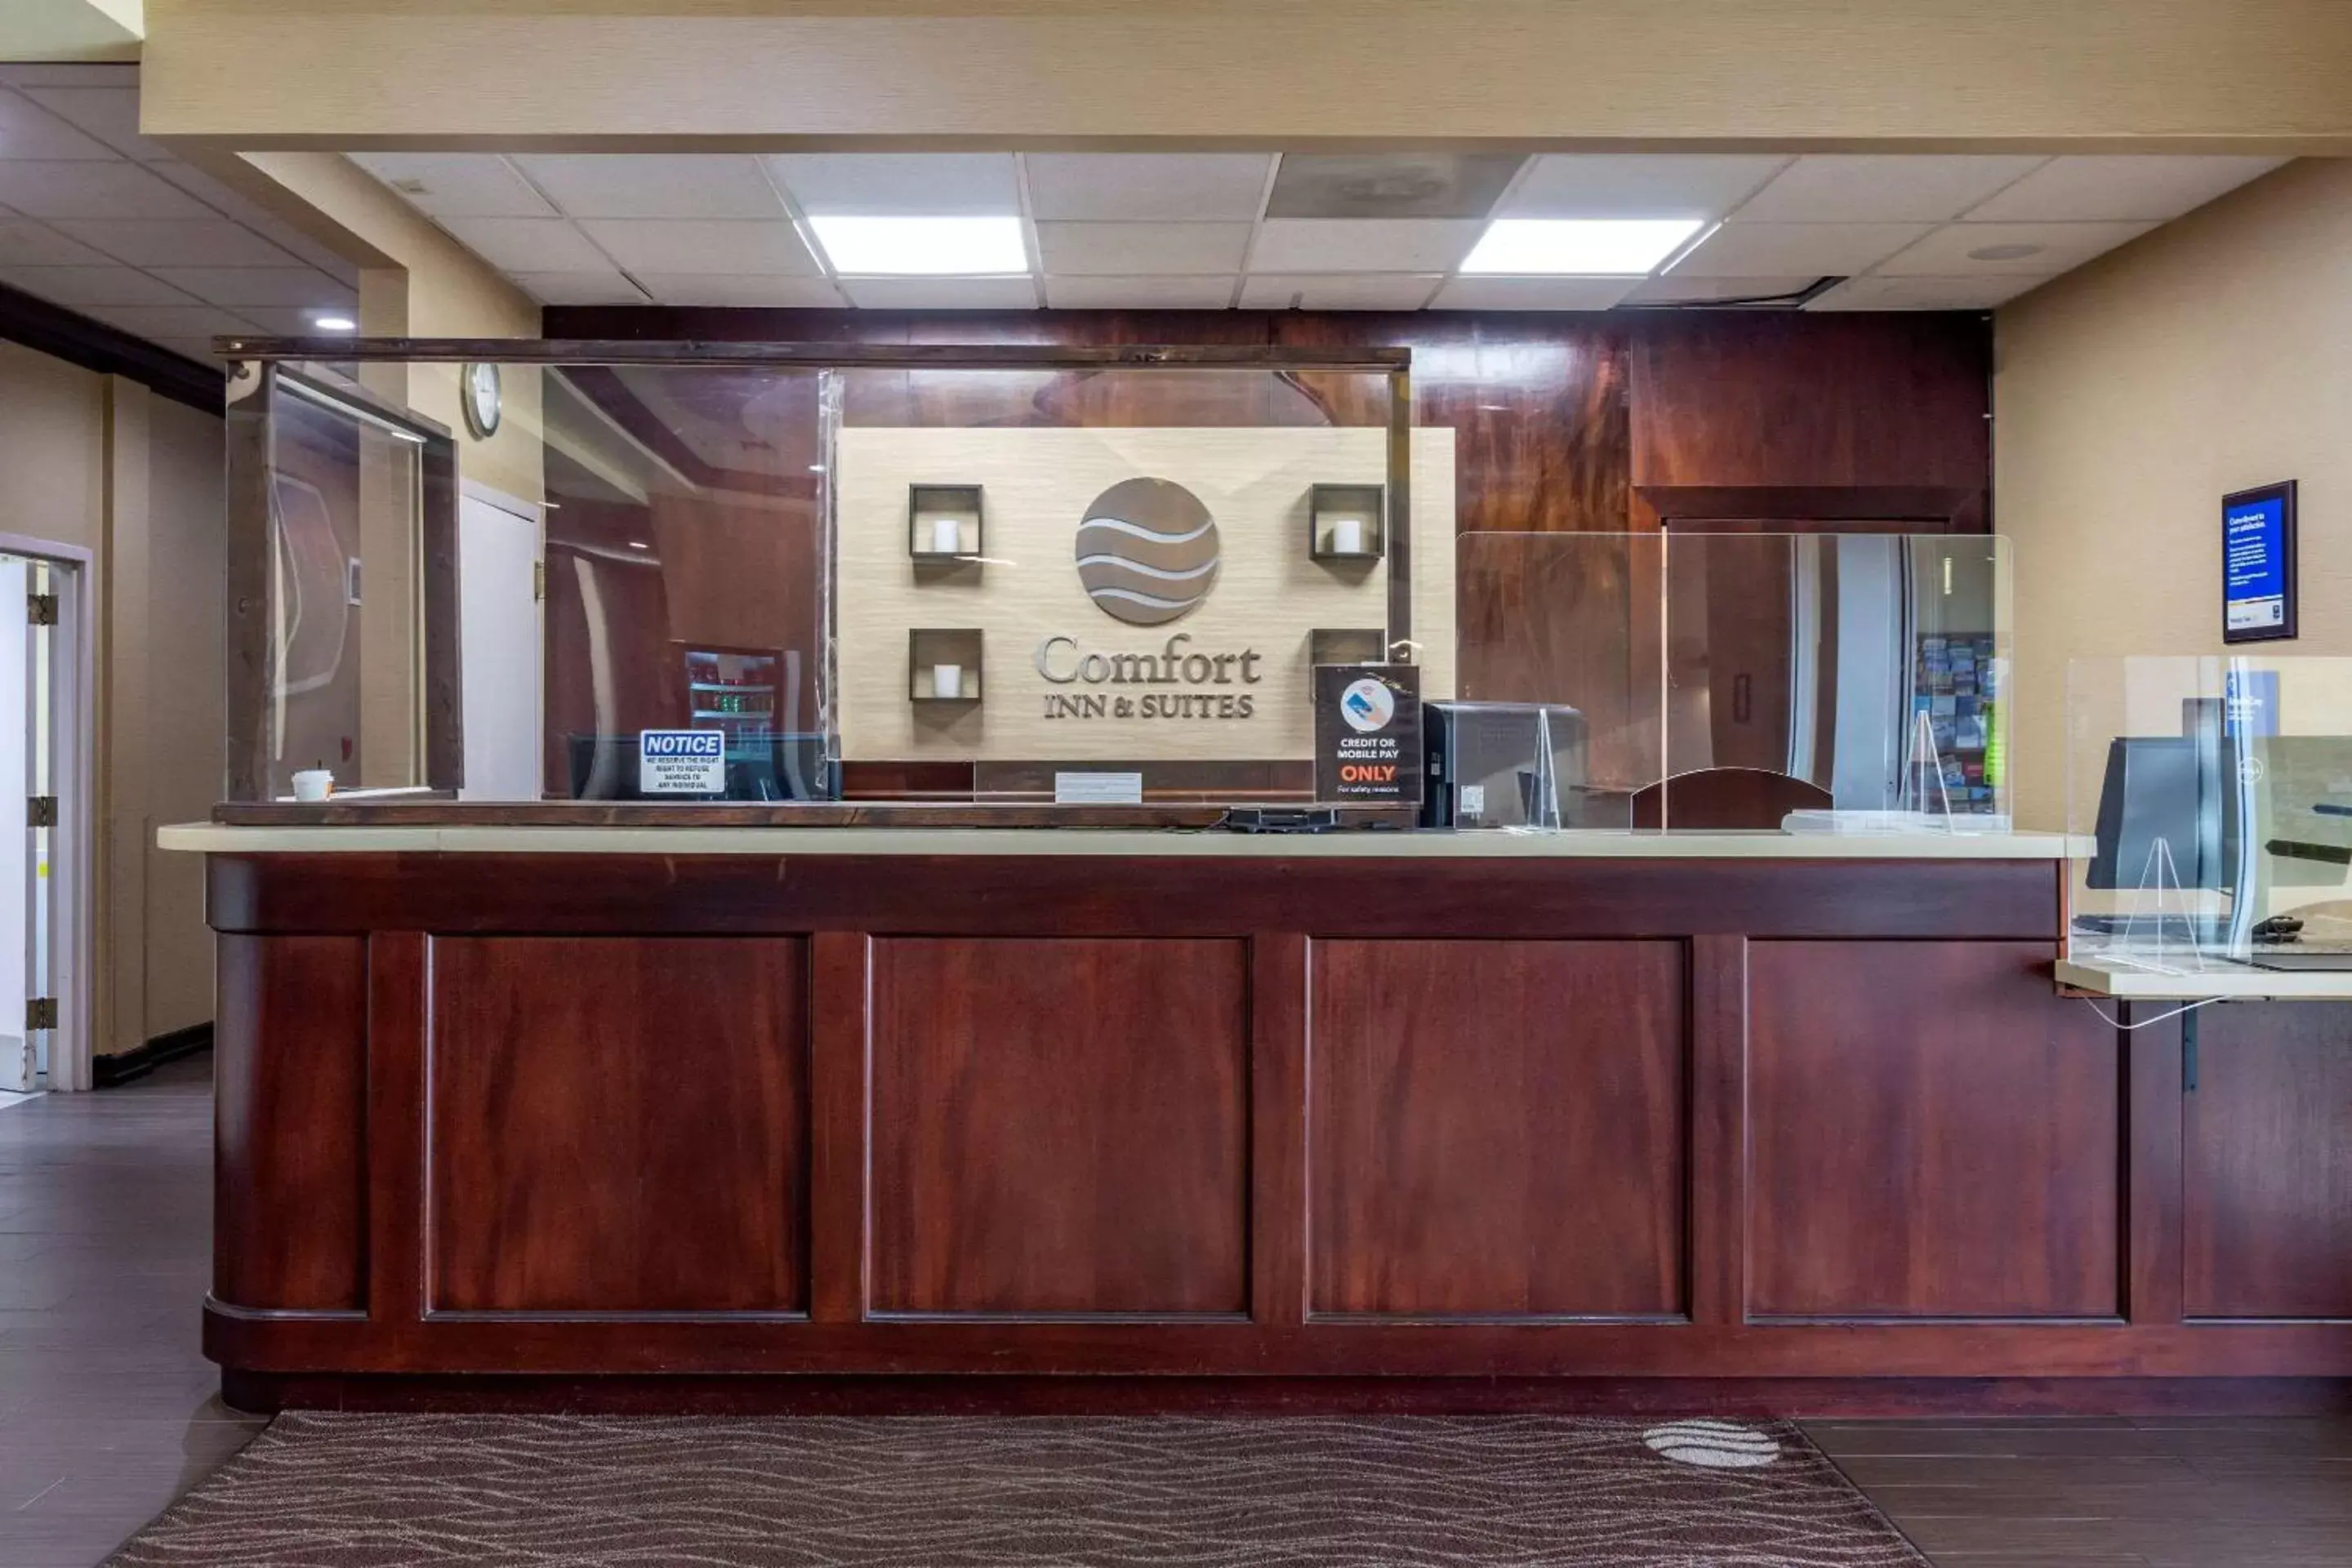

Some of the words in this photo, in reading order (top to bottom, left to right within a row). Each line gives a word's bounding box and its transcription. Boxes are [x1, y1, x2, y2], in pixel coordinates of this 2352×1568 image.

[1033, 632, 1262, 684] Comfort
[1044, 693, 1107, 719] INN
[1114, 696, 1134, 719] &
[1140, 693, 1254, 719] SUITES
[646, 736, 719, 753] NOTICE
[1340, 737, 1378, 747] CREDIT
[1379, 737, 1396, 747] OR
[1337, 750, 1378, 759] MOBILE
[1379, 750, 1399, 759] PAY
[1340, 765, 1396, 782] ONLY
